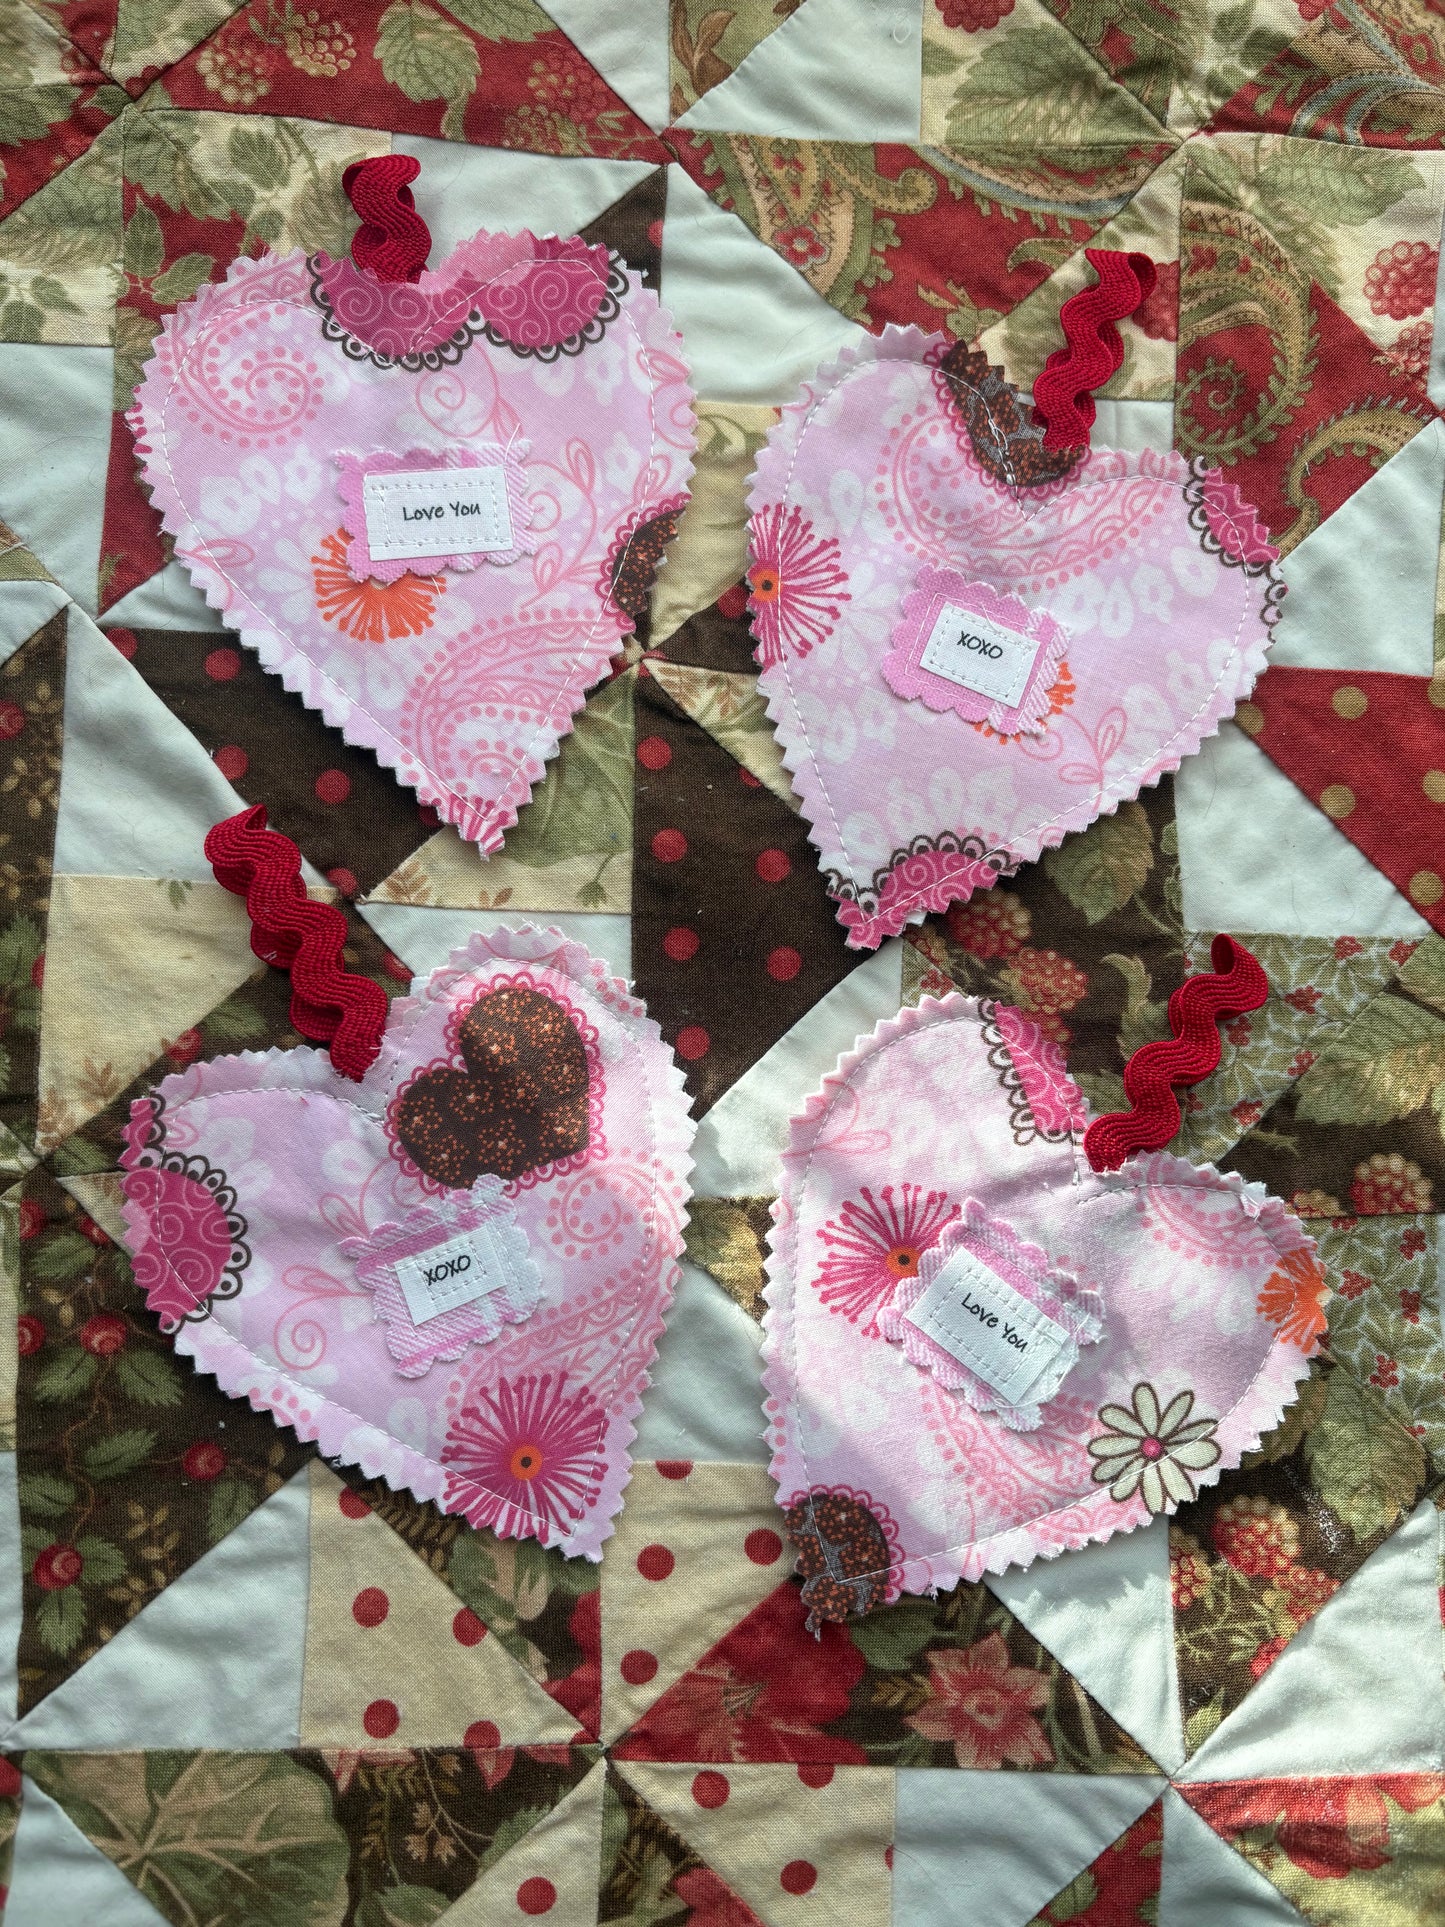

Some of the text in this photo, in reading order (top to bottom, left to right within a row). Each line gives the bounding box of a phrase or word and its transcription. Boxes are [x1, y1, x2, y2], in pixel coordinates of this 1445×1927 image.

[402, 501, 481, 521] Love You
[956, 630, 1003, 659] XOXO
[423, 1254, 471, 1287] XOXO
[961, 1292, 1028, 1353] Love You
